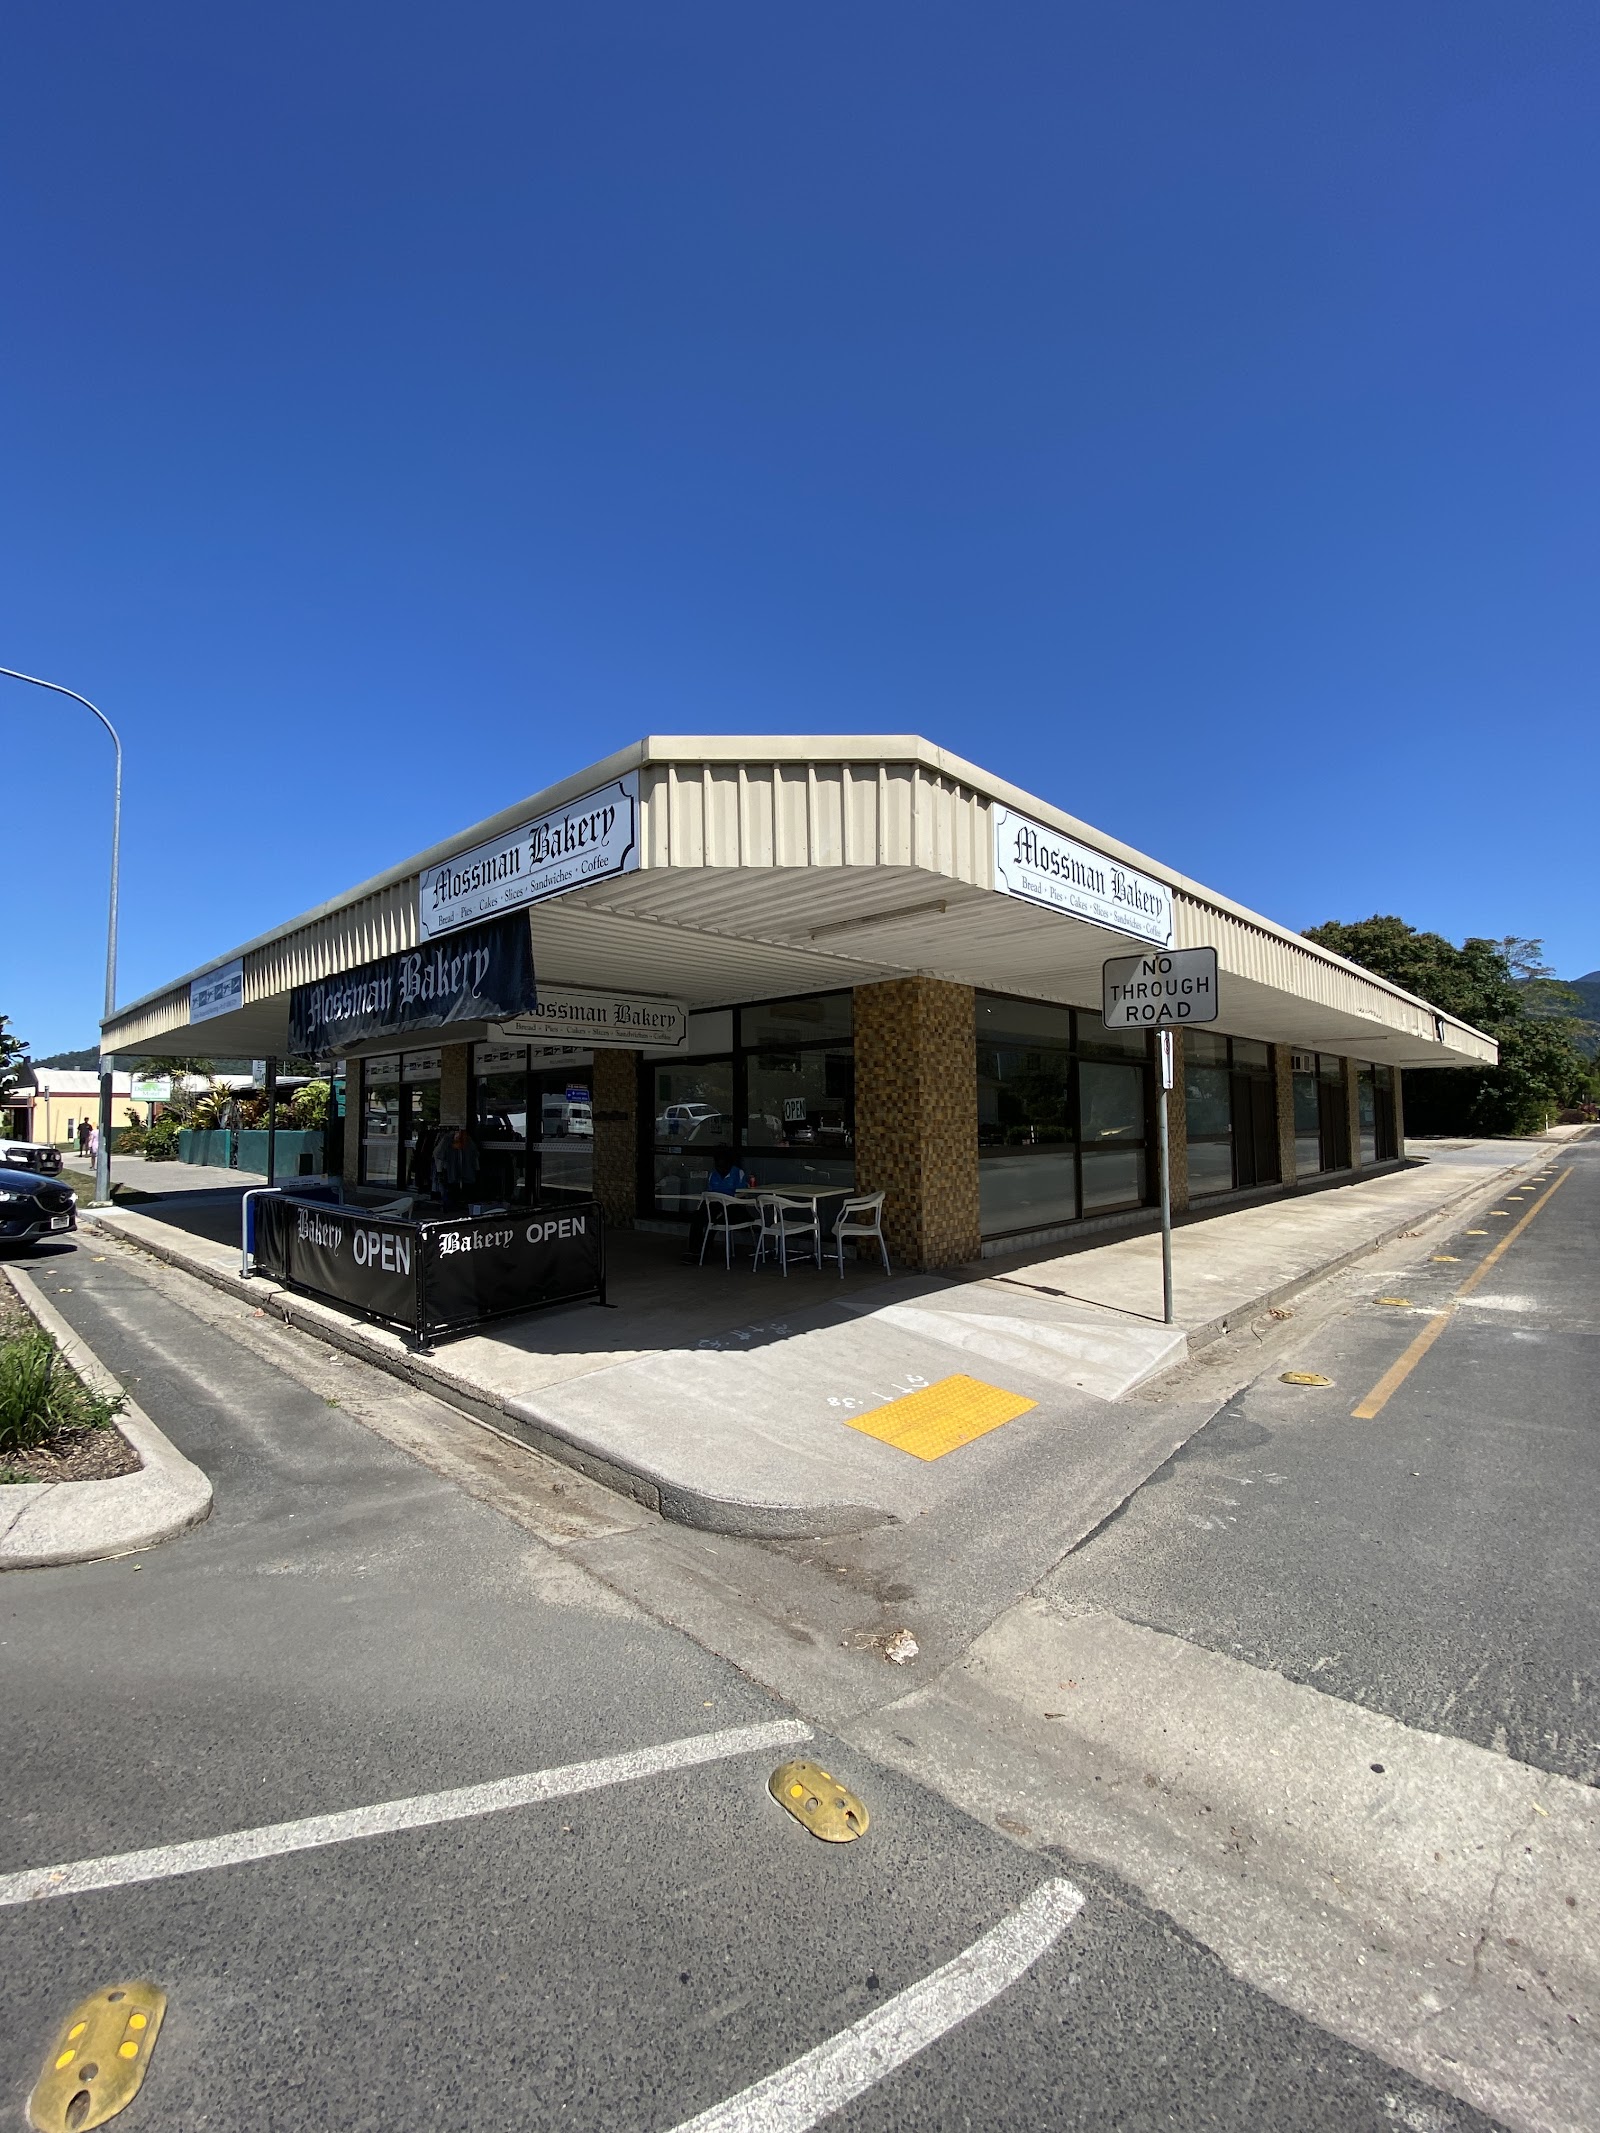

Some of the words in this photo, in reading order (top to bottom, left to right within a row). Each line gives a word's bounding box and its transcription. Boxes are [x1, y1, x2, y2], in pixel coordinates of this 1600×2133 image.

[432, 846, 521, 909] Mossman
[528, 805, 615, 873] Bakery
[1013, 826, 1105, 895] Mossman
[1110, 867, 1163, 924] Bakery
[438, 911, 455, 926] Bread
[460, 905, 473, 919] Pies
[479, 895, 498, 912] Cakes
[504, 886, 524, 902] Slices
[530, 869, 573, 893] Sandwiches
[581, 854, 609, 873] Coffee
[1021, 875, 1042, 894] Bread
[1050, 886, 1063, 902] Pies
[1069, 894, 1088, 911] Cakes
[1093, 903, 1109, 919] Slices
[1113, 910, 1142, 931] Sandwiches
[1146, 922, 1161, 938] Coffee
[1110, 976, 1209, 1001] THROUGH
[1142, 958, 1172, 976] NO
[307, 977, 391, 1034] Mossman
[398, 946, 490, 1013] Bakery
[1126, 1001, 1191, 1022] ROAD
[515, 1022, 536, 1031] Bread
[521, 1002, 607, 1022] ossman
[614, 1003, 676, 1031] Bakery
[786, 1100, 806, 1119] OPEN
[296, 1207, 343, 1258] Bakery
[353, 1229, 411, 1276] OPEN
[438, 1229, 514, 1259] Bakery
[526, 1216, 586, 1244] OPEN
